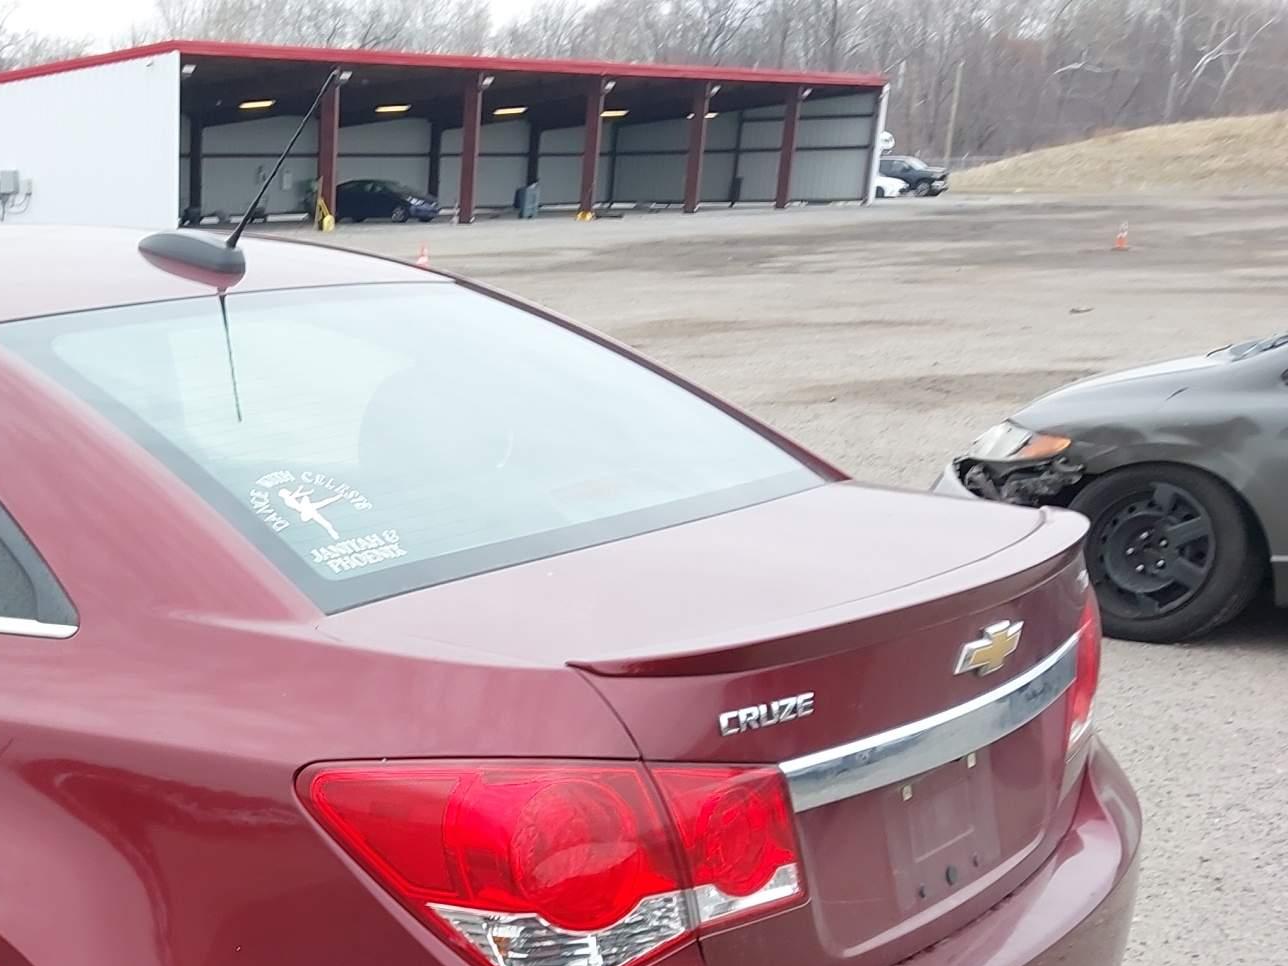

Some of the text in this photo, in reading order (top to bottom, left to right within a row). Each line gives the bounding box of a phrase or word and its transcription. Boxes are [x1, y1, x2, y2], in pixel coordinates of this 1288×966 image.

[384, 528, 400, 543] &
[326, 543, 408, 574] PHOENIX
[719, 691, 814, 736] CRUZE
